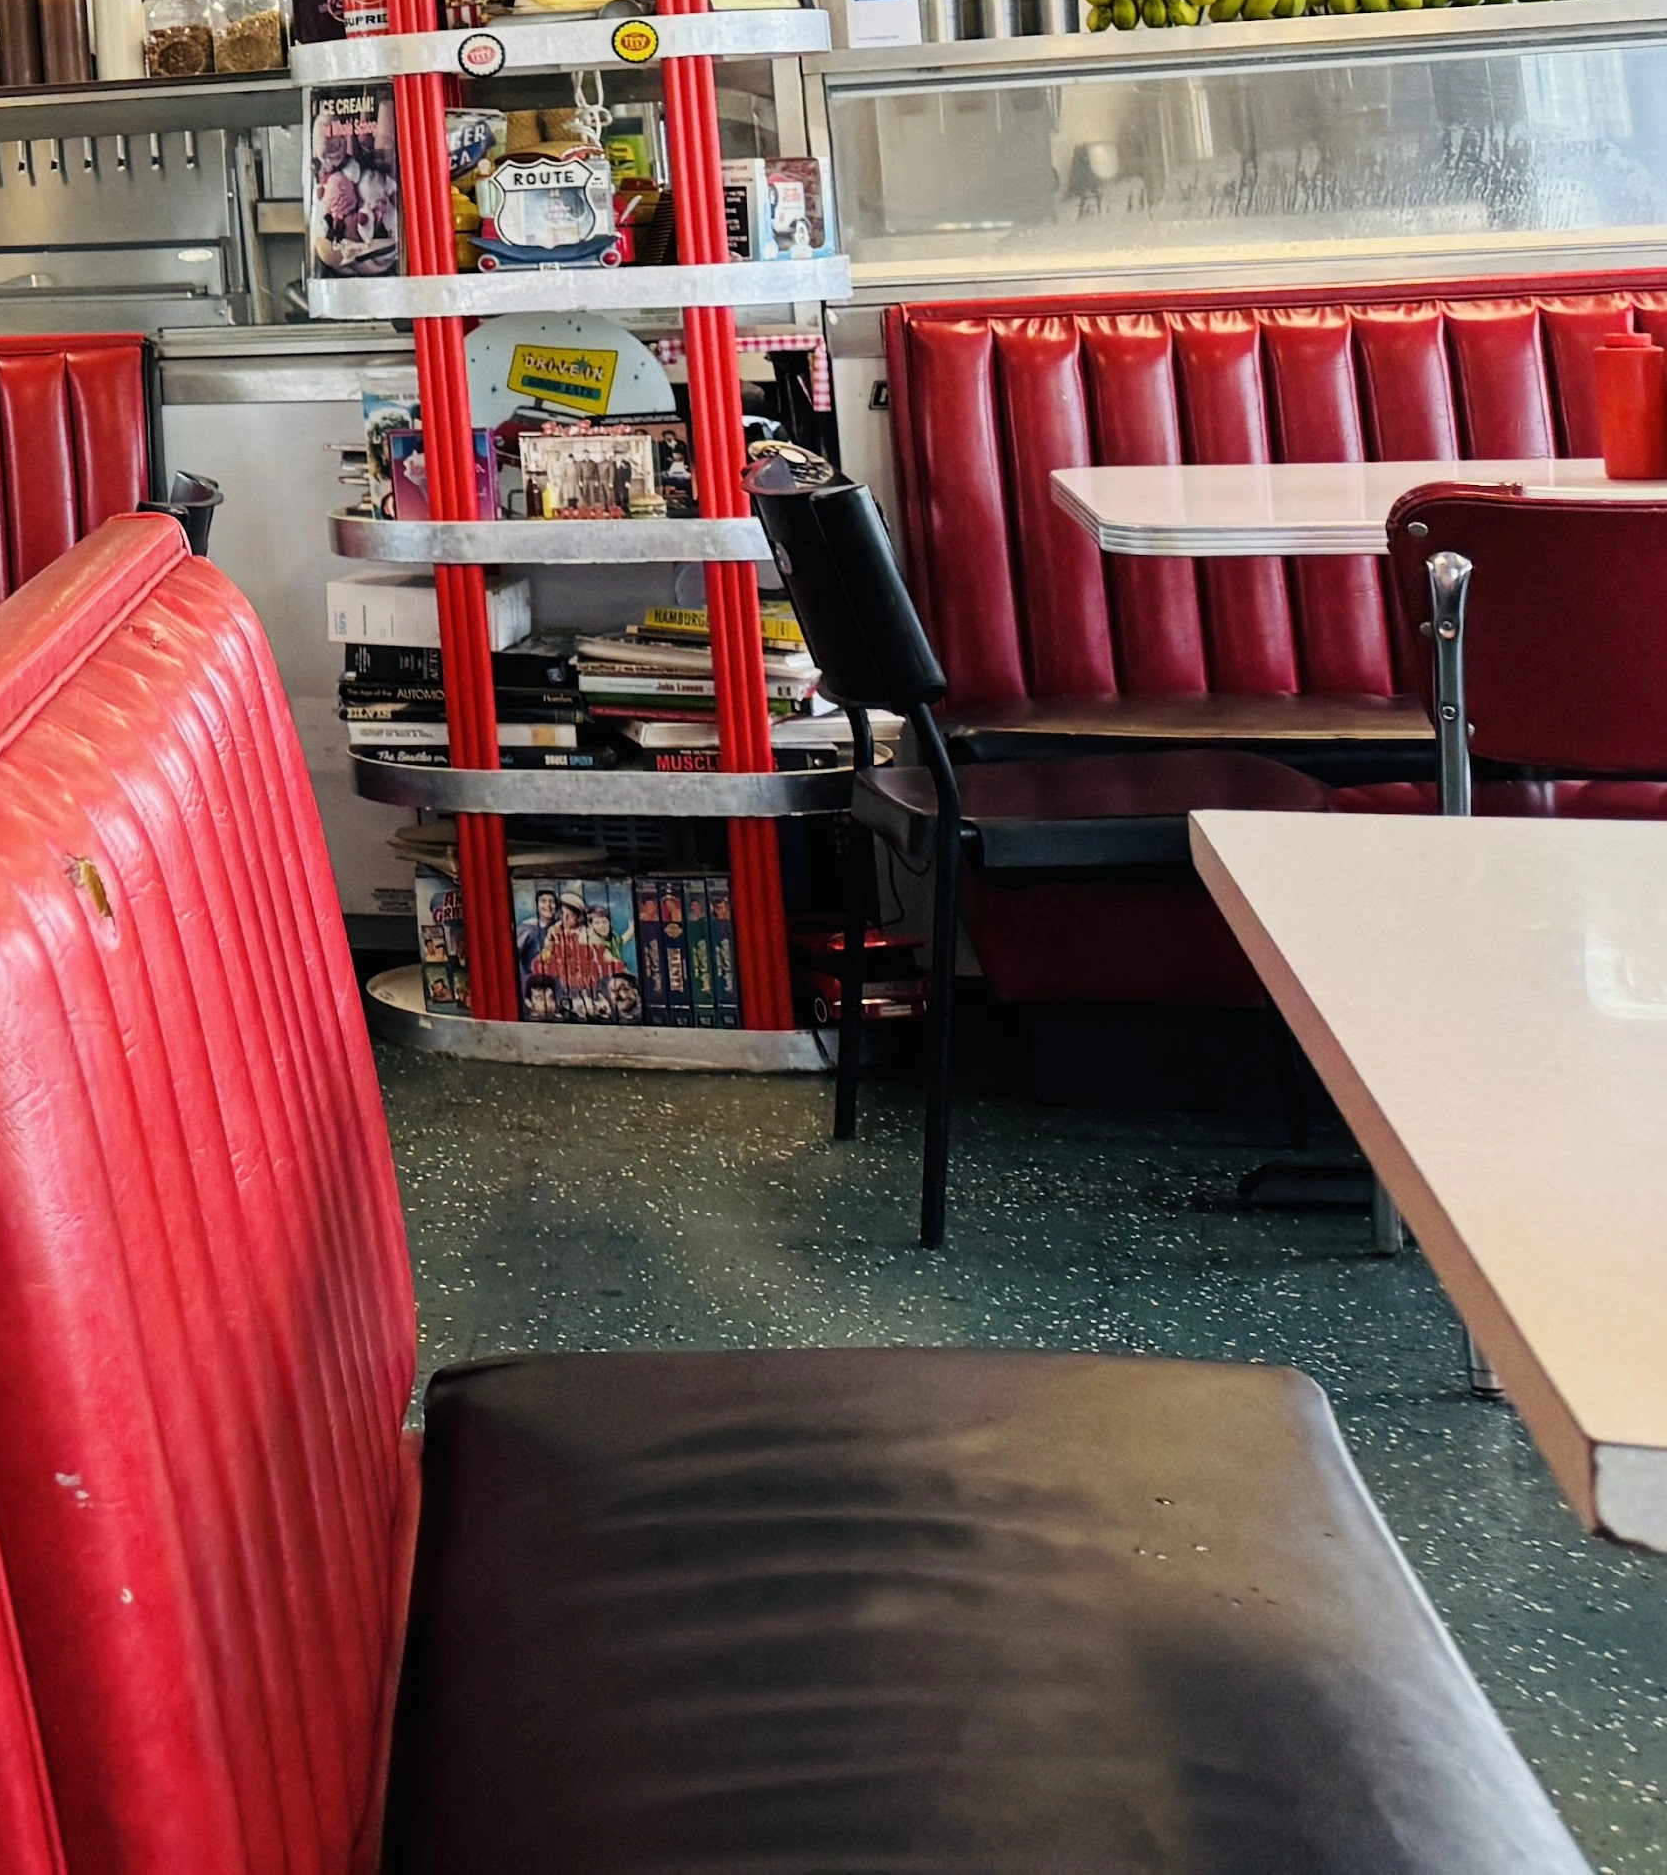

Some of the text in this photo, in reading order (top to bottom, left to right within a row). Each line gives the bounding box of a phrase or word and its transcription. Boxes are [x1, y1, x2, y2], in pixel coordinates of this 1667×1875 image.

[336, 96, 375, 115] CREAM!
[512, 169, 575, 186] ROUTE
[523, 353, 580, 377] DRIVE
